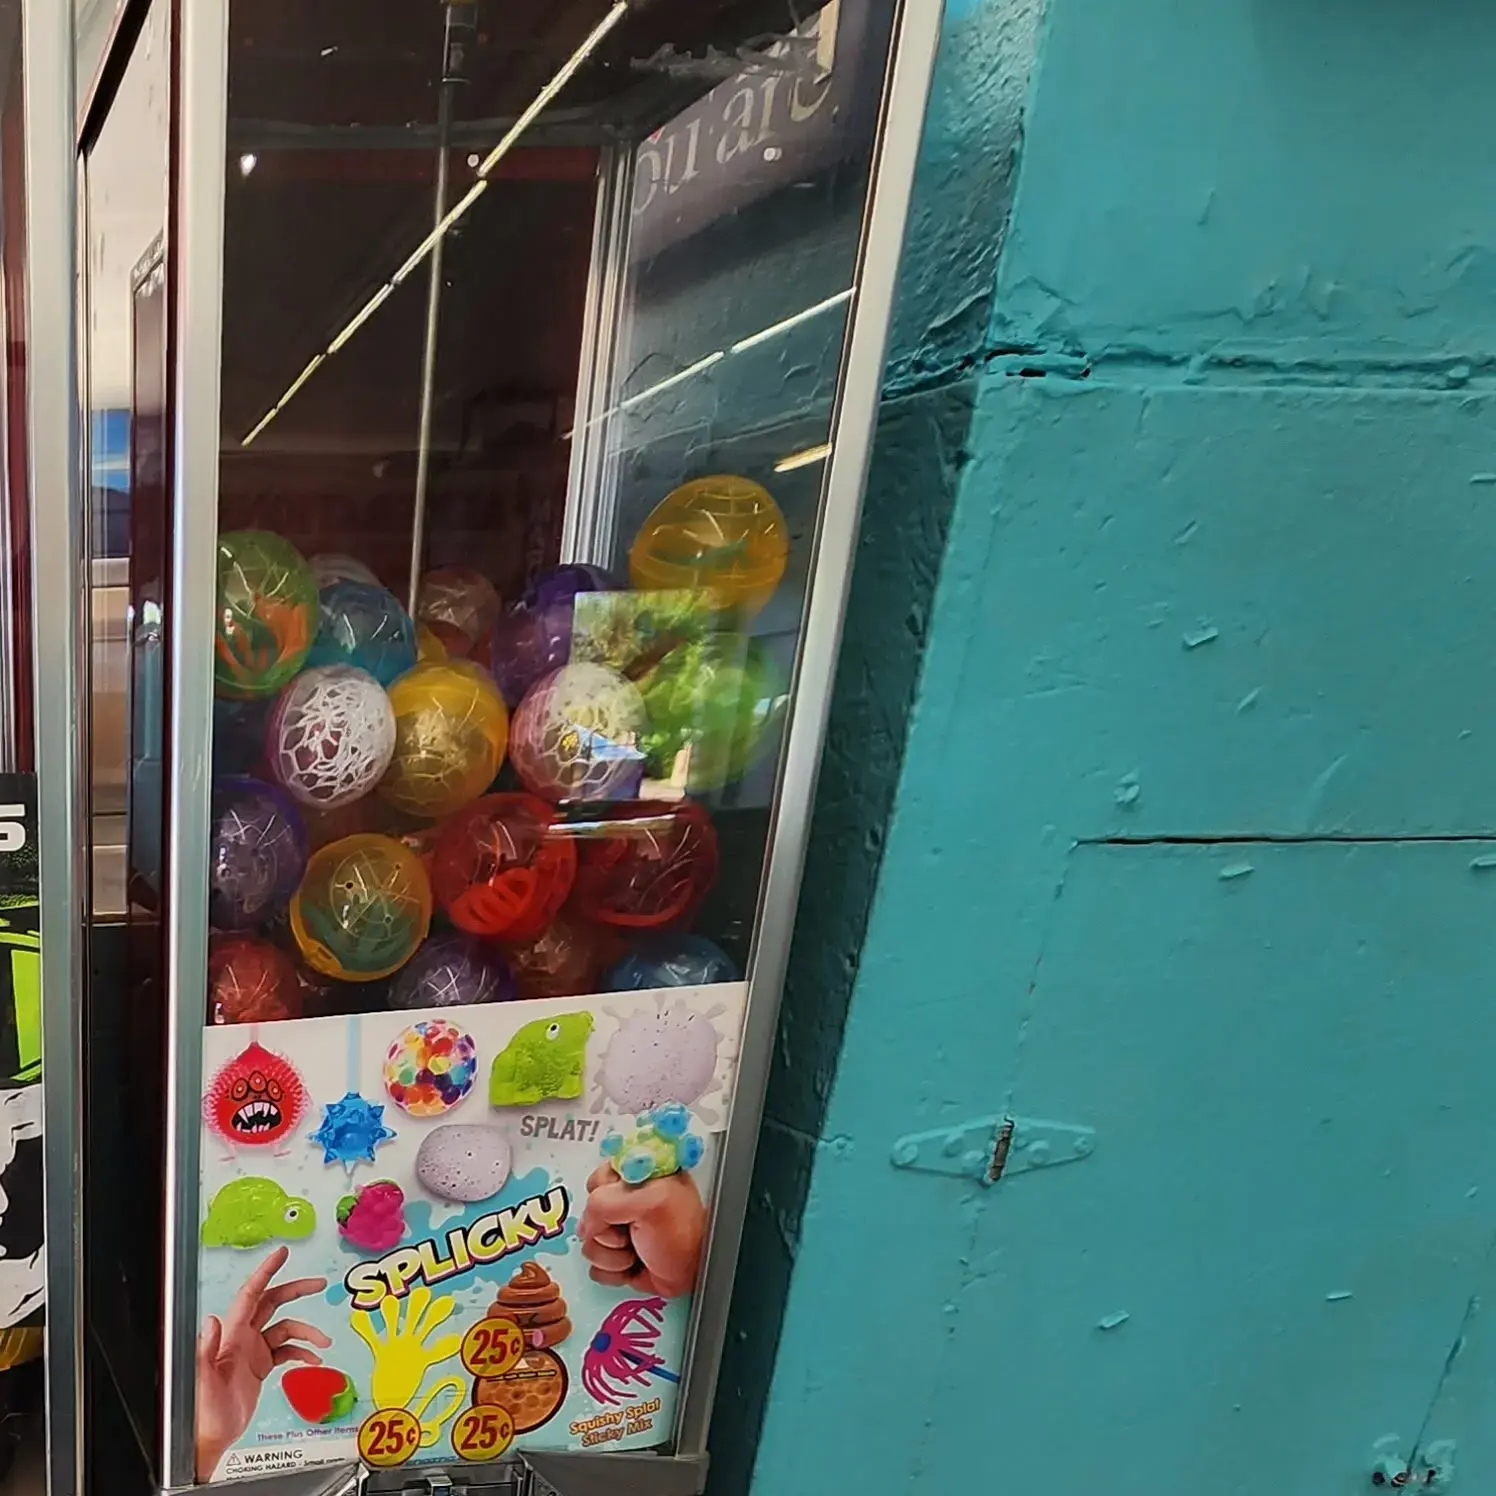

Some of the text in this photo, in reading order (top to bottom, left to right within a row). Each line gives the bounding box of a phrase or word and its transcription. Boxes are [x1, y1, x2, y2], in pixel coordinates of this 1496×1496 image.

[520, 1115, 600, 1142] SPLAT!
[344, 1186, 570, 1310] SPLICKY
[470, 1329, 521, 1365] 25¢
[569, 1397, 661, 1435] Squishy Splat
[626, 1418, 653, 1435] Mix
[257, 1433, 283, 1441] These
[286, 1431, 303, 1439] Plus
[306, 1428, 332, 1436] Other
[367, 1420, 416, 1455] 25¢
[460, 1415, 510, 1450] 25¢
[226, 1464, 263, 1474] CHOKING
[265, 1462, 296, 1470] HAZARD
[244, 1449, 303, 1463] WARNING
